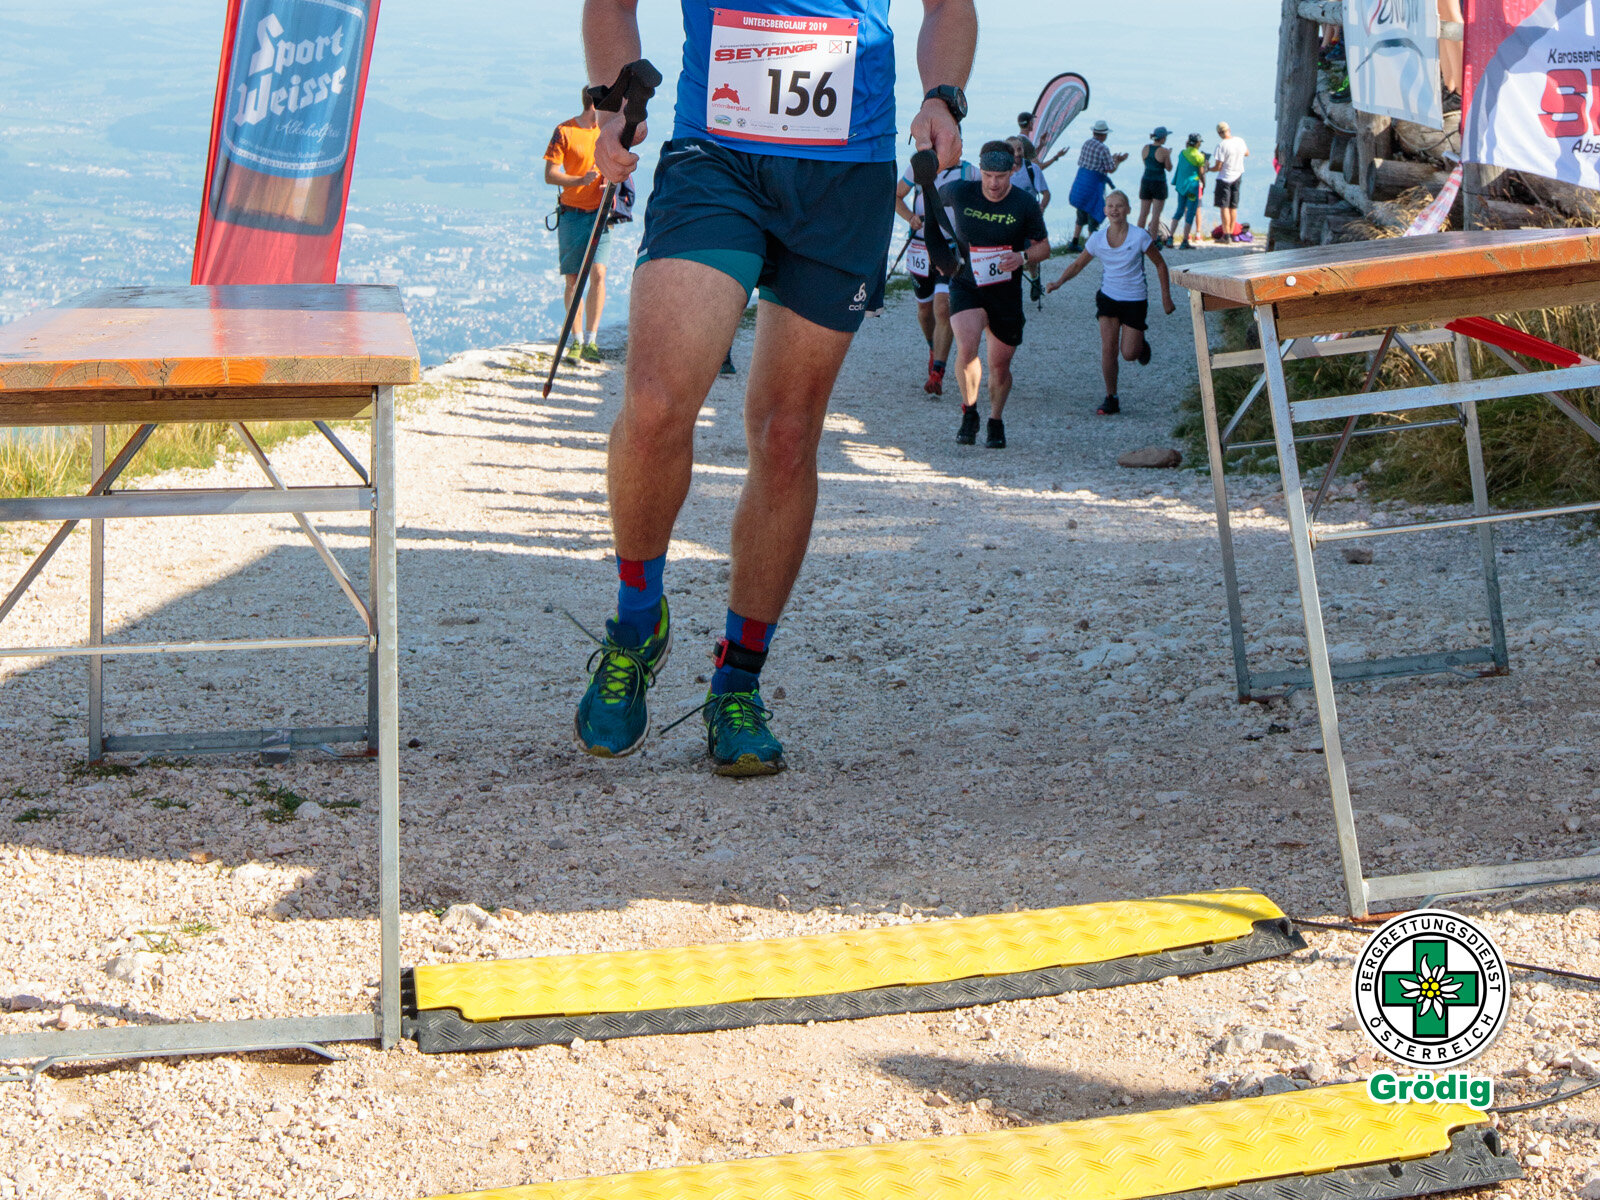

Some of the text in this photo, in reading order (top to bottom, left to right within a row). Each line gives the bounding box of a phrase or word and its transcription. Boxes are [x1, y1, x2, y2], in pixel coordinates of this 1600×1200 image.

[743, 16, 827, 31] UNTERSBERGLAUF 2019
[248, 13, 344, 77] Sport
[714, 43, 817, 62] SEYRINGER
[845, 41, 852, 54] T
[232, 65, 347, 127] Weisse
[768, 68, 837, 117] 156
[963, 207, 1006, 223] CRAFT
[912, 256, 925, 270] 165
